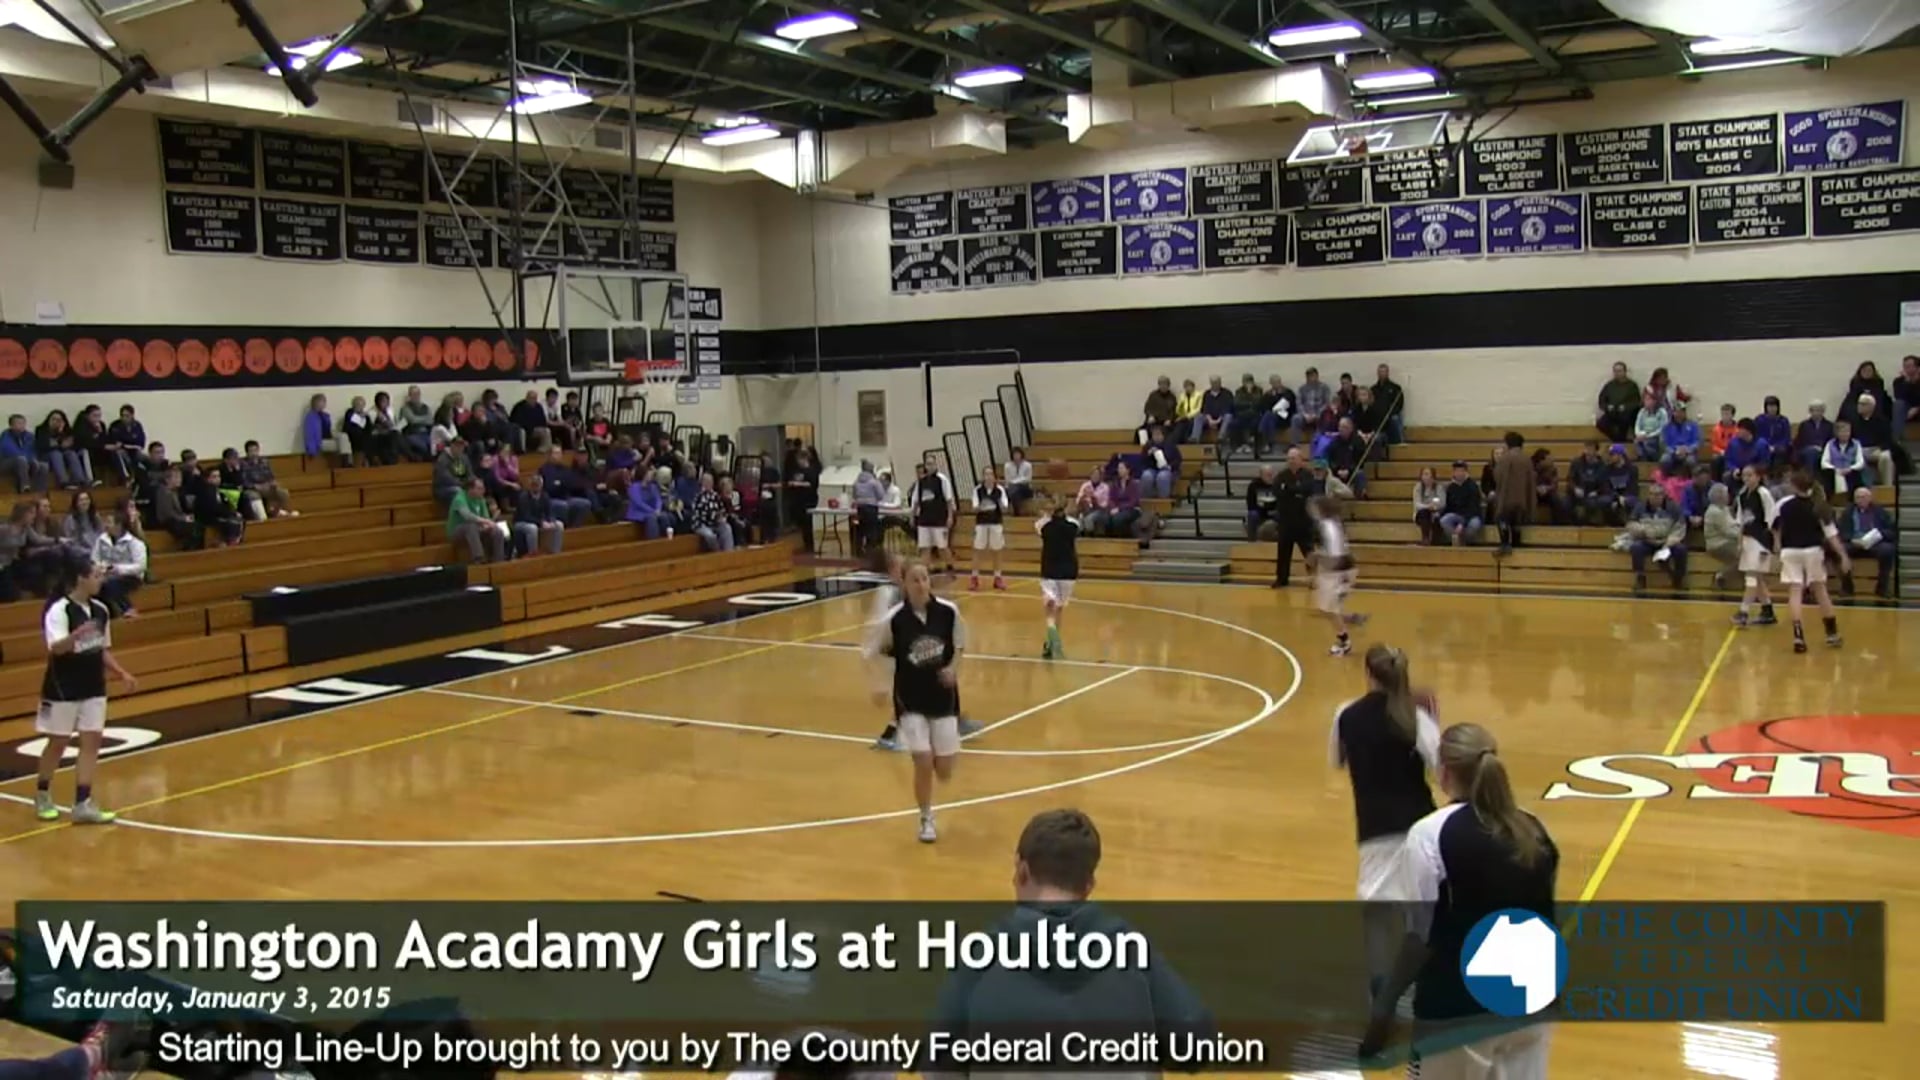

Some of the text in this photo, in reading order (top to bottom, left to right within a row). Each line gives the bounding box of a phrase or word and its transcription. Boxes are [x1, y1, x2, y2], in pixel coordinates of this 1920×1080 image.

[1678, 119, 1771, 137] STATE CHAMPIONS
[1826, 117, 1860, 130] AWARD
[1575, 128, 1651, 145] EASTERN MAINE
[1675, 133, 1773, 152] BOYS BASKETBALL
[1473, 140, 1515, 153] EASTERN
[1580, 142, 1648, 156] CHAMPIONS
[1792, 142, 1818, 154] EAST
[1479, 149, 1542, 163] CHAMPIONS
[1696, 152, 1740, 163] CLASS
[1589, 174, 1629, 184] CLASS
[1821, 178, 1857, 191] STATE
[1390, 181, 1427, 192] CLASS
[1487, 181, 1525, 191] CLASS
[1700, 181, 1801, 198] STATE RUNNERS-UP
[1596, 192, 1684, 207] STATE CHAMPIONS
[1594, 205, 1687, 220] CHEERLEADING
[1841, 205, 1887, 217] CLASS
[1326, 211, 1381, 227] CHAMPIONS
[1717, 217, 1786, 229] SOFTBALL
[1301, 224, 1378, 241] CHEERLEADING
[1612, 221, 1655, 231] CLASS
[1724, 228, 1767, 239] CLASS
[1315, 241, 1351, 251] CLASS
